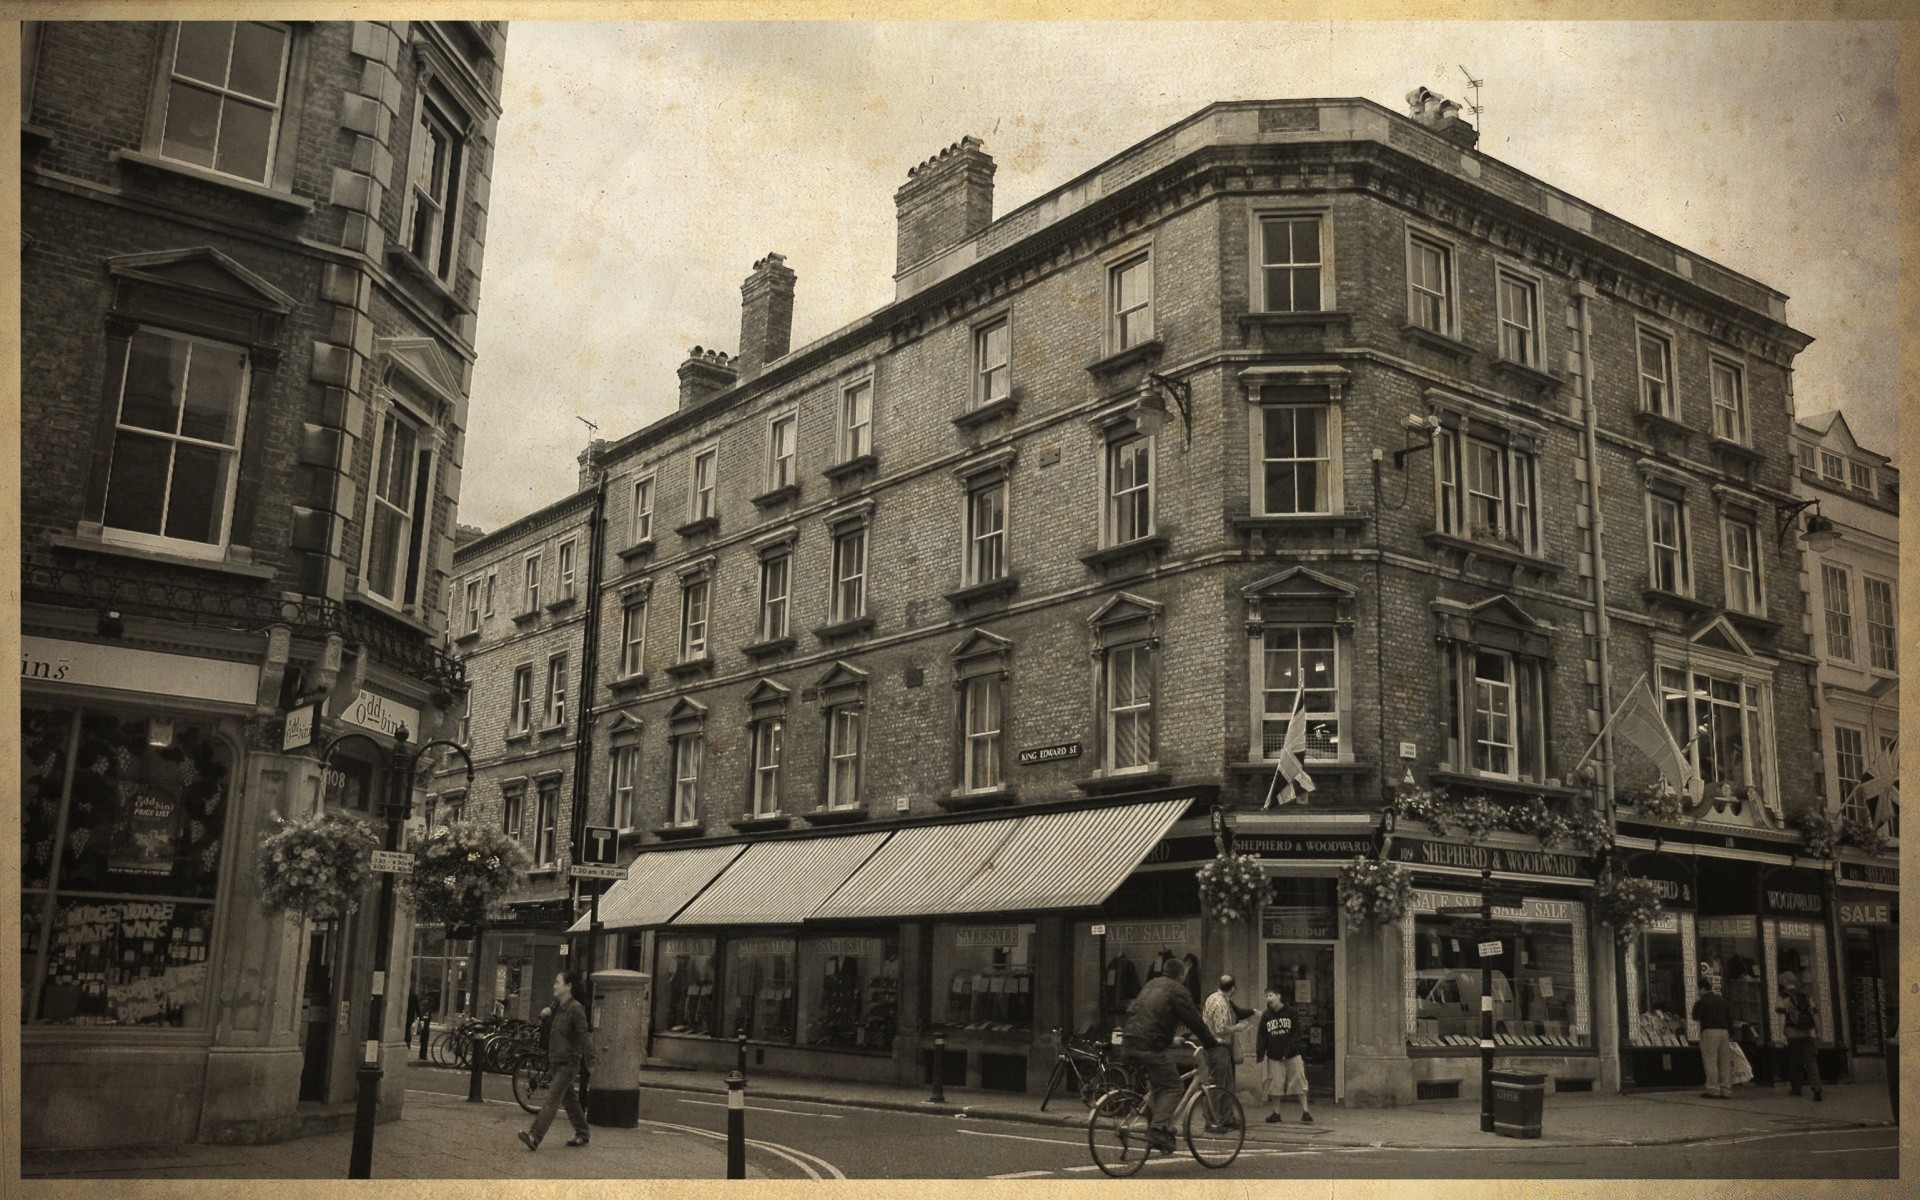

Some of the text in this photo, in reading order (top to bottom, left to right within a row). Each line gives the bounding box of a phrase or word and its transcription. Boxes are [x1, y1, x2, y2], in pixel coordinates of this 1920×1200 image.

[356, 694, 402, 736] Oddbin
[1021, 745, 1077, 761] KING EDWARD ST
[134, 796, 176, 812] Oddbins
[133, 808, 171, 818] PRICE LIST
[1234, 840, 1371, 852] SHEPHERD & WOODWARD
[1400, 842, 1577, 876] 109 SHEPHERD & WOODWARD
[1683, 884, 1691, 900] &
[1413, 892, 1450, 910] SALE
[1455, 896, 1479, 908] SAL
[1535, 903, 1568, 918] SALE
[1768, 890, 1821, 911] WOODWARD
[1841, 905, 1887, 922] SALE
[122, 919, 168, 939] WINK
[1106, 926, 1134, 942] ALE
[1143, 925, 1181, 941] SALE
[1272, 923, 1328, 936] Barbour
[1699, 919, 1750, 935] SALE
[1780, 921, 1810, 937] SALE
[957, 928, 1018, 944] SALE SALE
